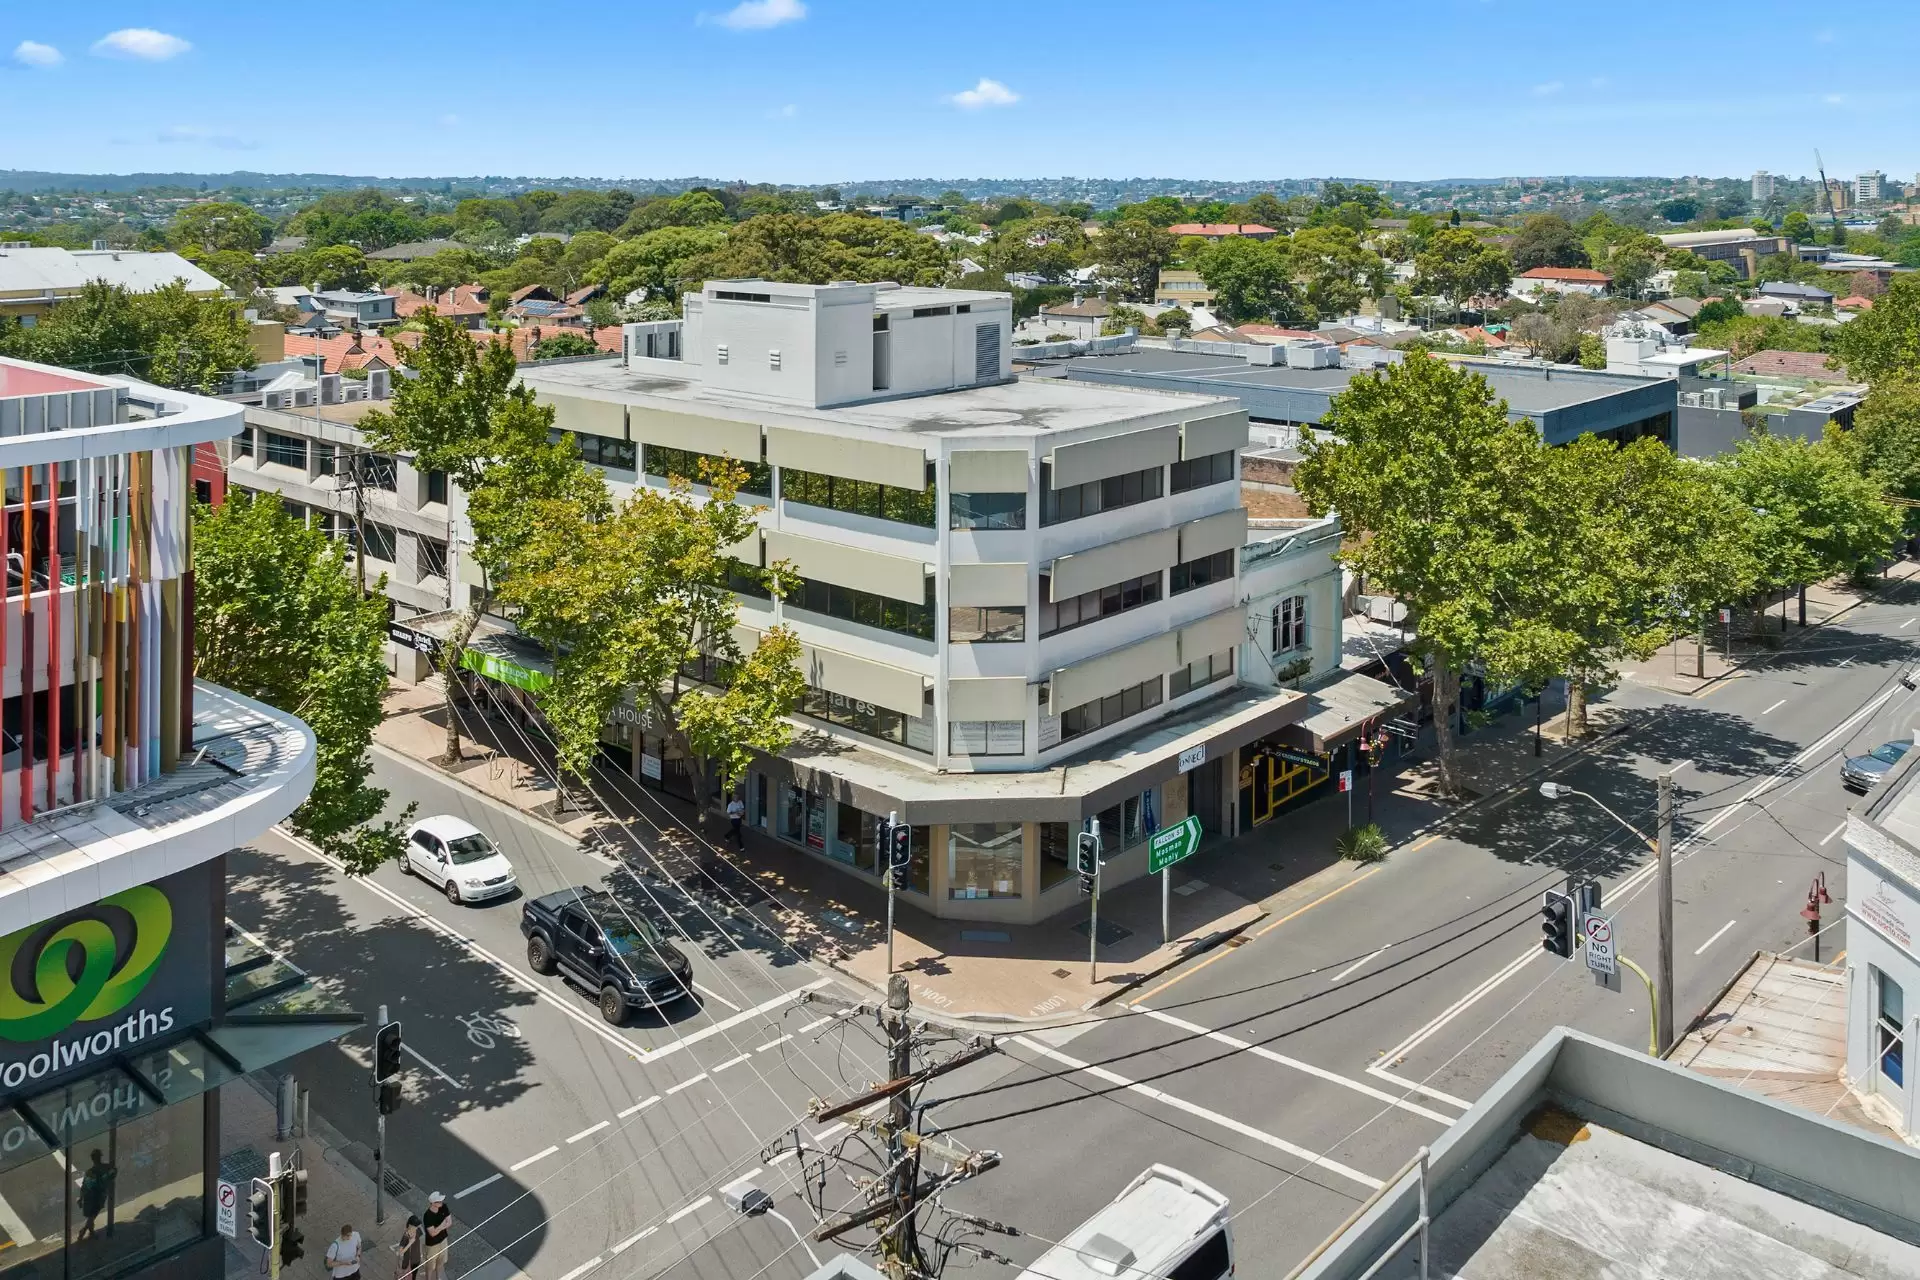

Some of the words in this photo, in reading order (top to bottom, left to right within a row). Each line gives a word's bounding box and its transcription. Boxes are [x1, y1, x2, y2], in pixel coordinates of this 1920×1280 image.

[618, 706, 653, 729] HOUSE
[1155, 832, 1175, 846] FALCON
[1156, 841, 1182, 858] Mosman
[1159, 851, 1179, 866] Manly
[1592, 942, 1608, 954] NO
[1589, 951, 1611, 963] RIGHT
[1590, 960, 1612, 971] TURN
[920, 988, 955, 1009] LOOK
[1034, 994, 1067, 1014] LOOK
[0, 1006, 175, 1088] oolworths
[221, 1207, 232, 1218] NO
